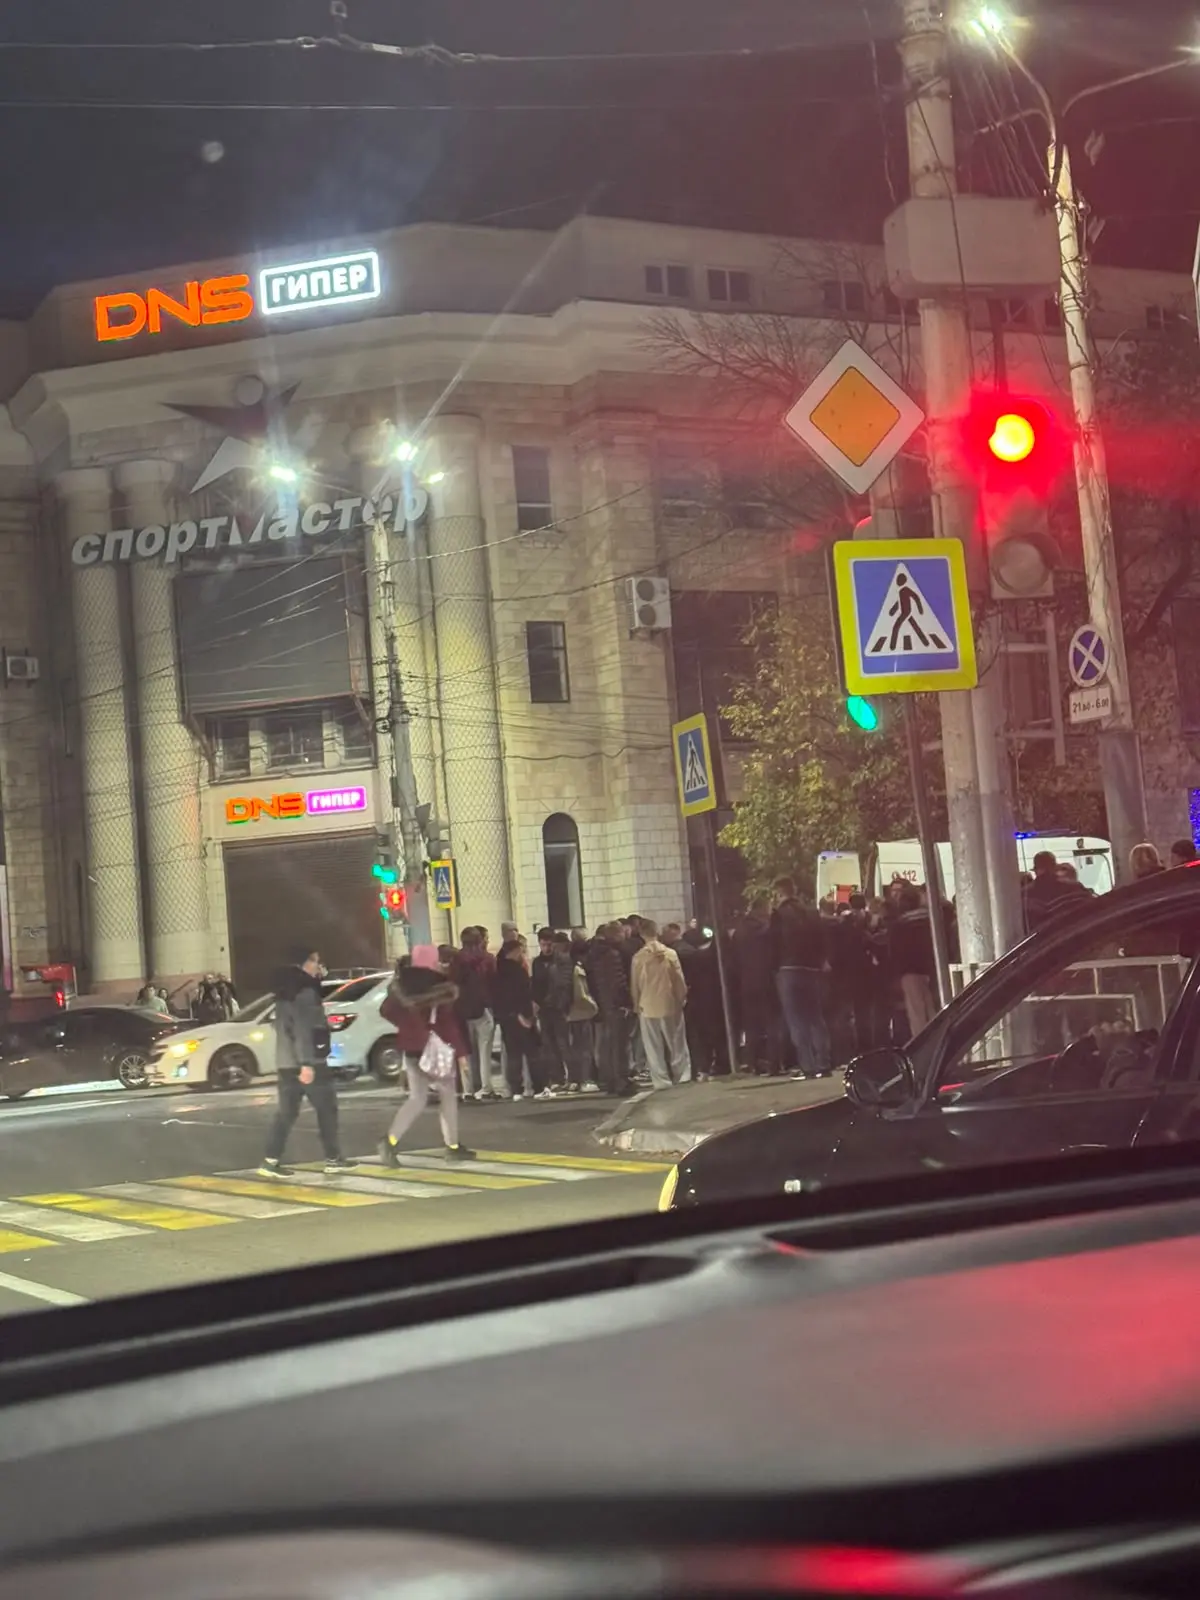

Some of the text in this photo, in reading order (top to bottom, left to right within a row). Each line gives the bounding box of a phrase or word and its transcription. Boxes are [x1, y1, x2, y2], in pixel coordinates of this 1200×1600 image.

[271, 263, 368, 304] ГИПЕР
[95, 274, 253, 341] DNS
[226, 792, 306, 823] DNS
[312, 791, 361, 809] ГИПЕР
